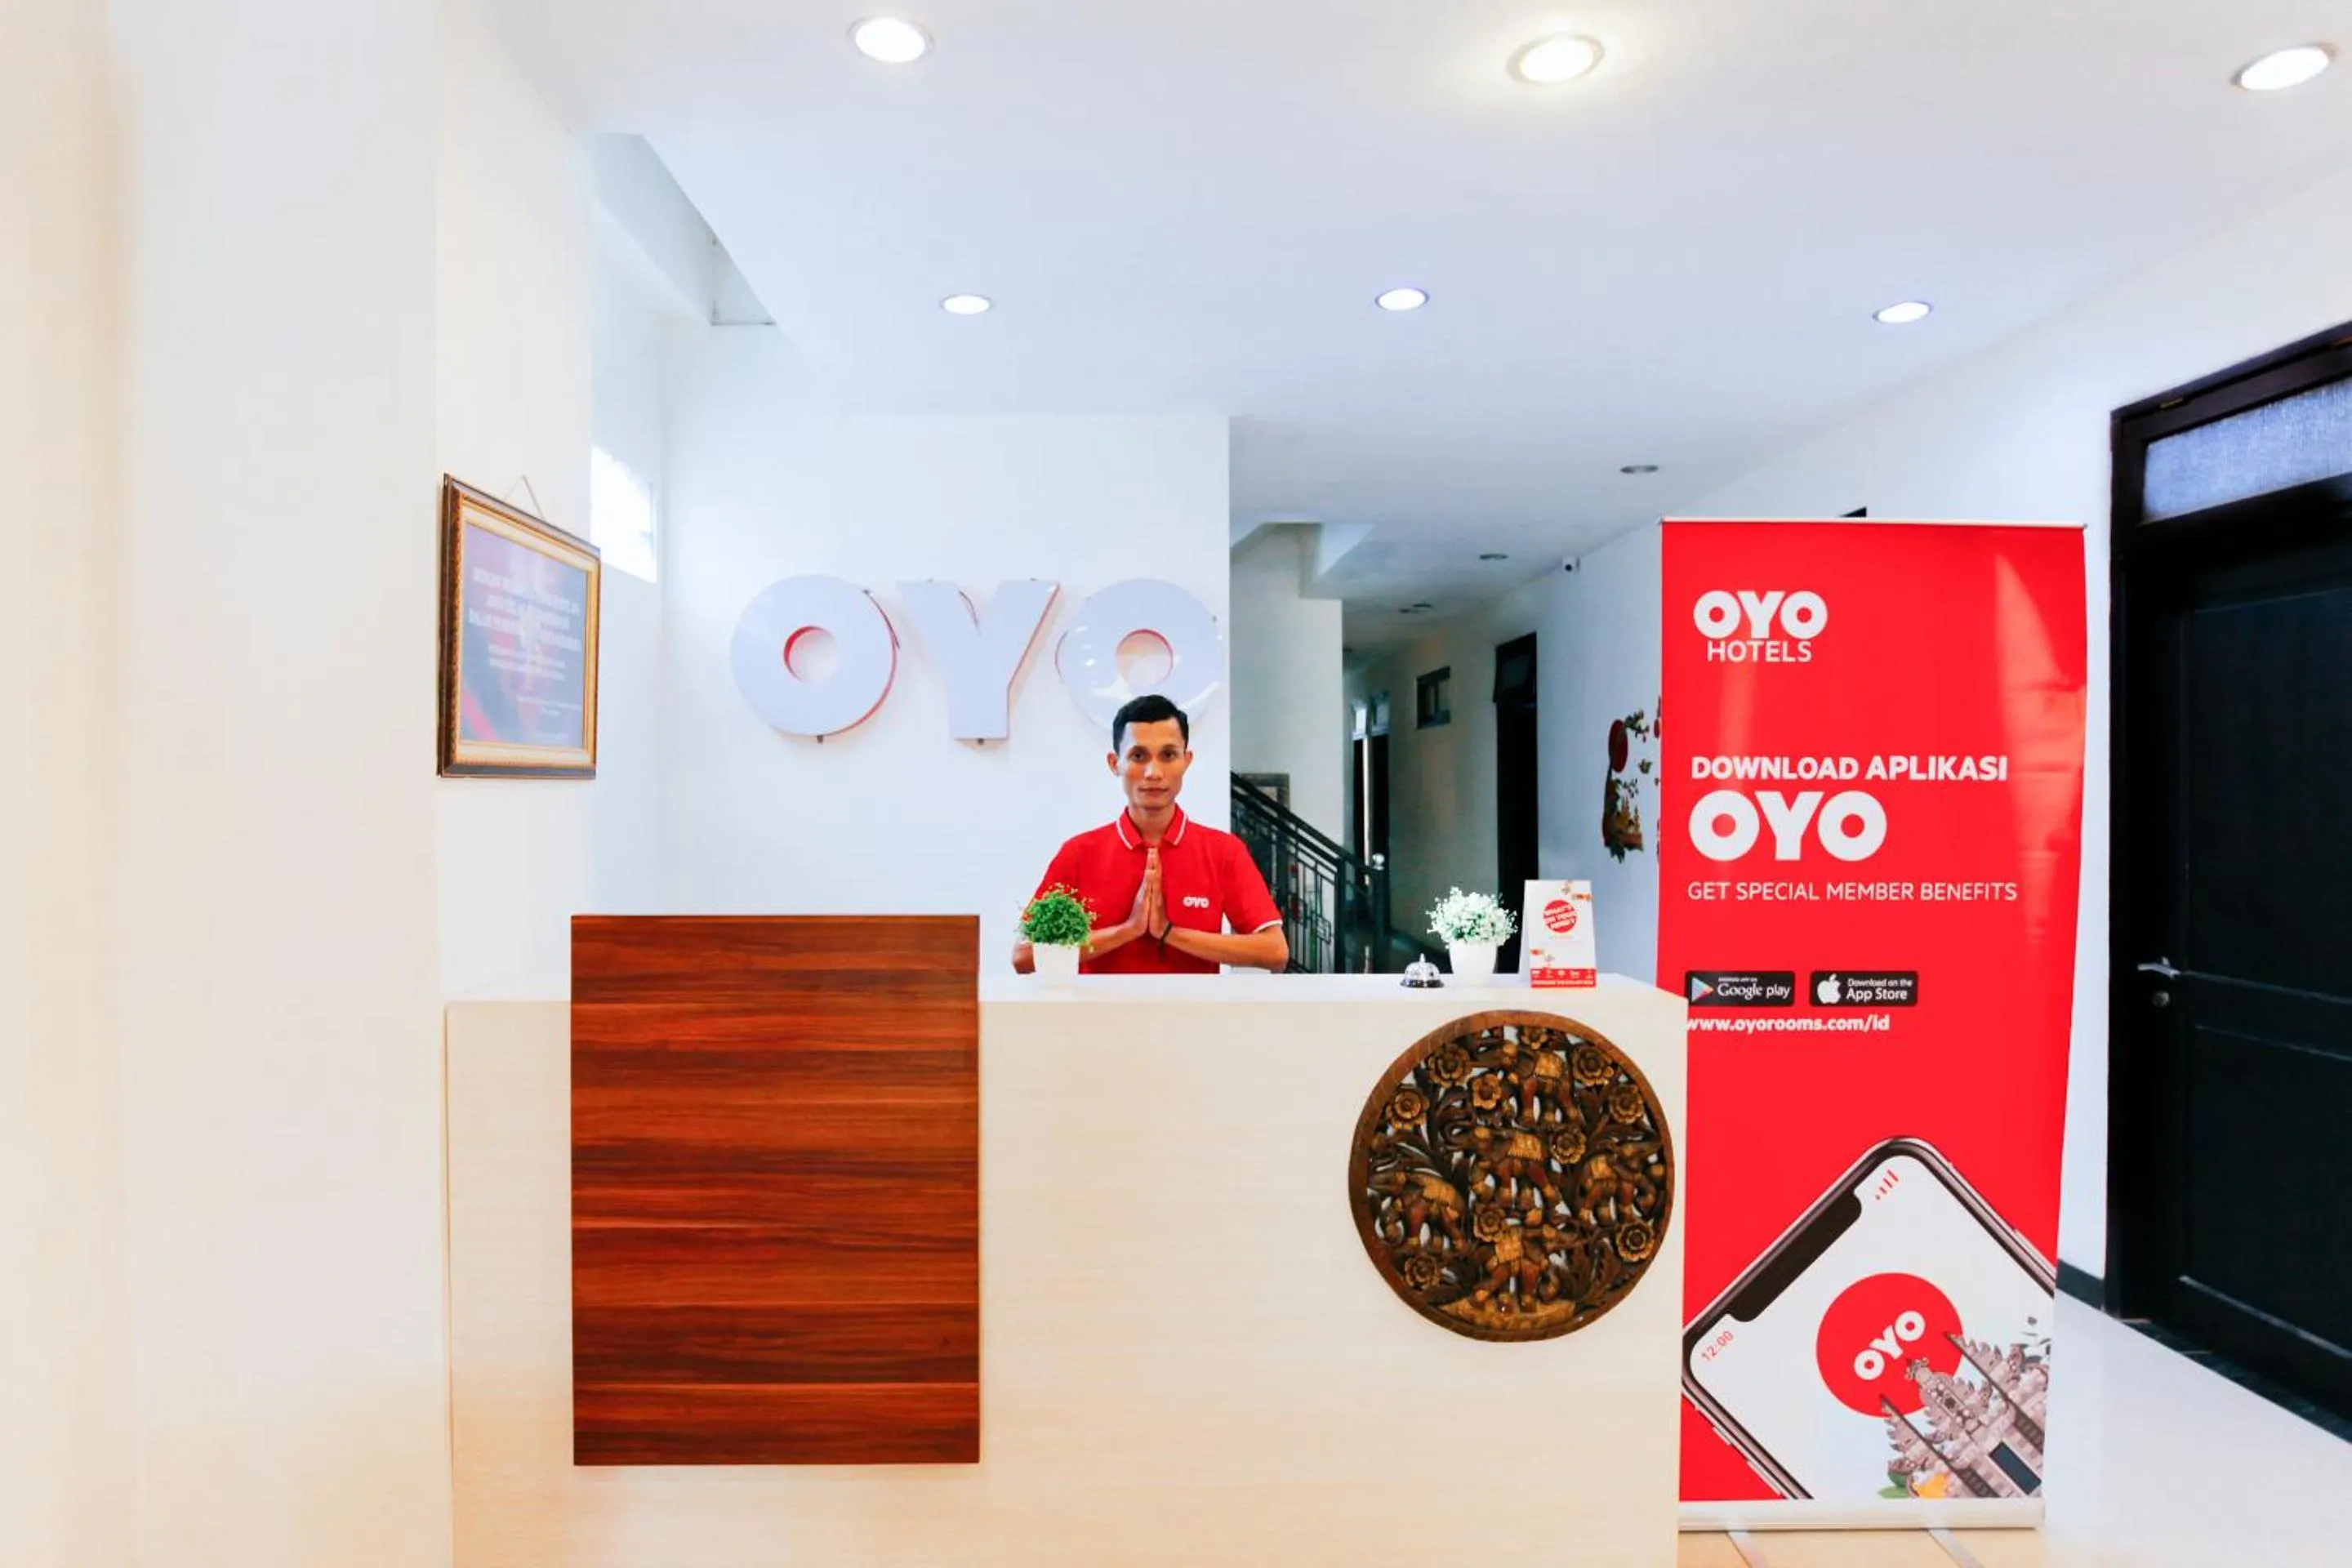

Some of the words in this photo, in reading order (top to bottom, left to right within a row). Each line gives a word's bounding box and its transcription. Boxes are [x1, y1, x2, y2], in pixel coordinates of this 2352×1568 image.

[1693, 590, 1829, 639] OYO
[730, 573, 1225, 741] OYO
[1706, 640, 1813, 662] HOTELS
[1691, 755, 1860, 781] DOWNLOAD
[1864, 755, 2008, 782] APLIKASI
[1688, 789, 1887, 862] OYO
[1687, 881, 1731, 901] GET
[1736, 881, 1820, 901] SPECIAL
[1826, 882, 1914, 901] MEMBER
[1920, 882, 2017, 901] BENEFITS
[1183, 896, 1209, 908] OYO
[1717, 982, 1762, 1000] Google
[1766, 983, 1791, 1000] play
[1848, 978, 1886, 987] Download
[1900, 978, 1912, 987] the
[1846, 987, 1873, 1002] App
[1875, 987, 1908, 1000] Store
[1687, 1014, 1890, 1035] www.oyorooms.com/id
[1854, 1311, 1925, 1380] OYO
